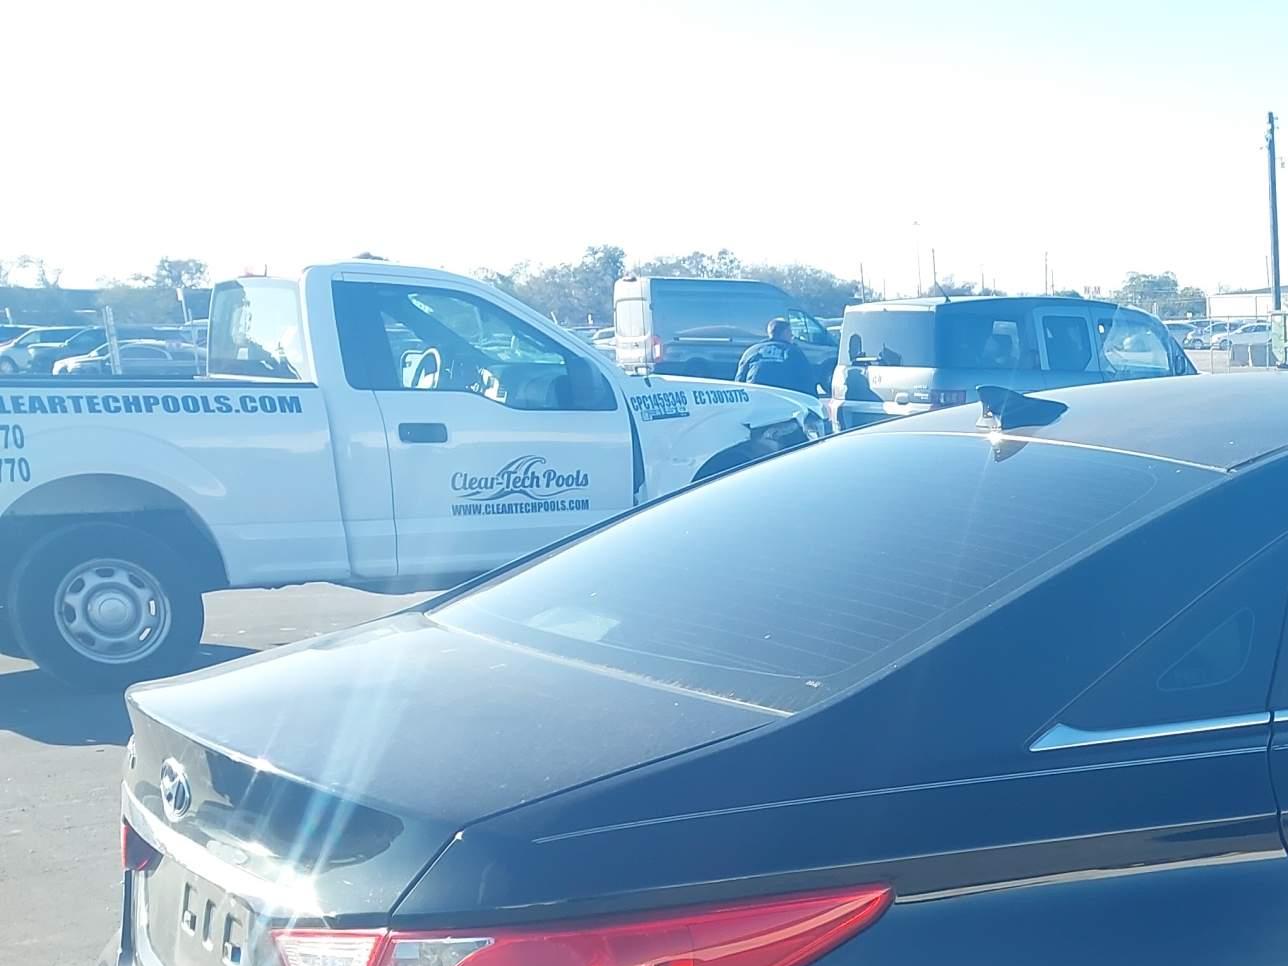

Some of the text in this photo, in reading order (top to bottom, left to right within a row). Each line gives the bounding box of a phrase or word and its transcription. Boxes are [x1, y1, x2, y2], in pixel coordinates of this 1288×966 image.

[0, 395, 303, 414] LEARTECHPOOLS.COM
[630, 391, 688, 412] CPC1459346
[0, 456, 31, 482] 70
[543, 469, 589, 488] Pools
[452, 499, 590, 516] WWW.CLEARTECHPOOLS.COM
